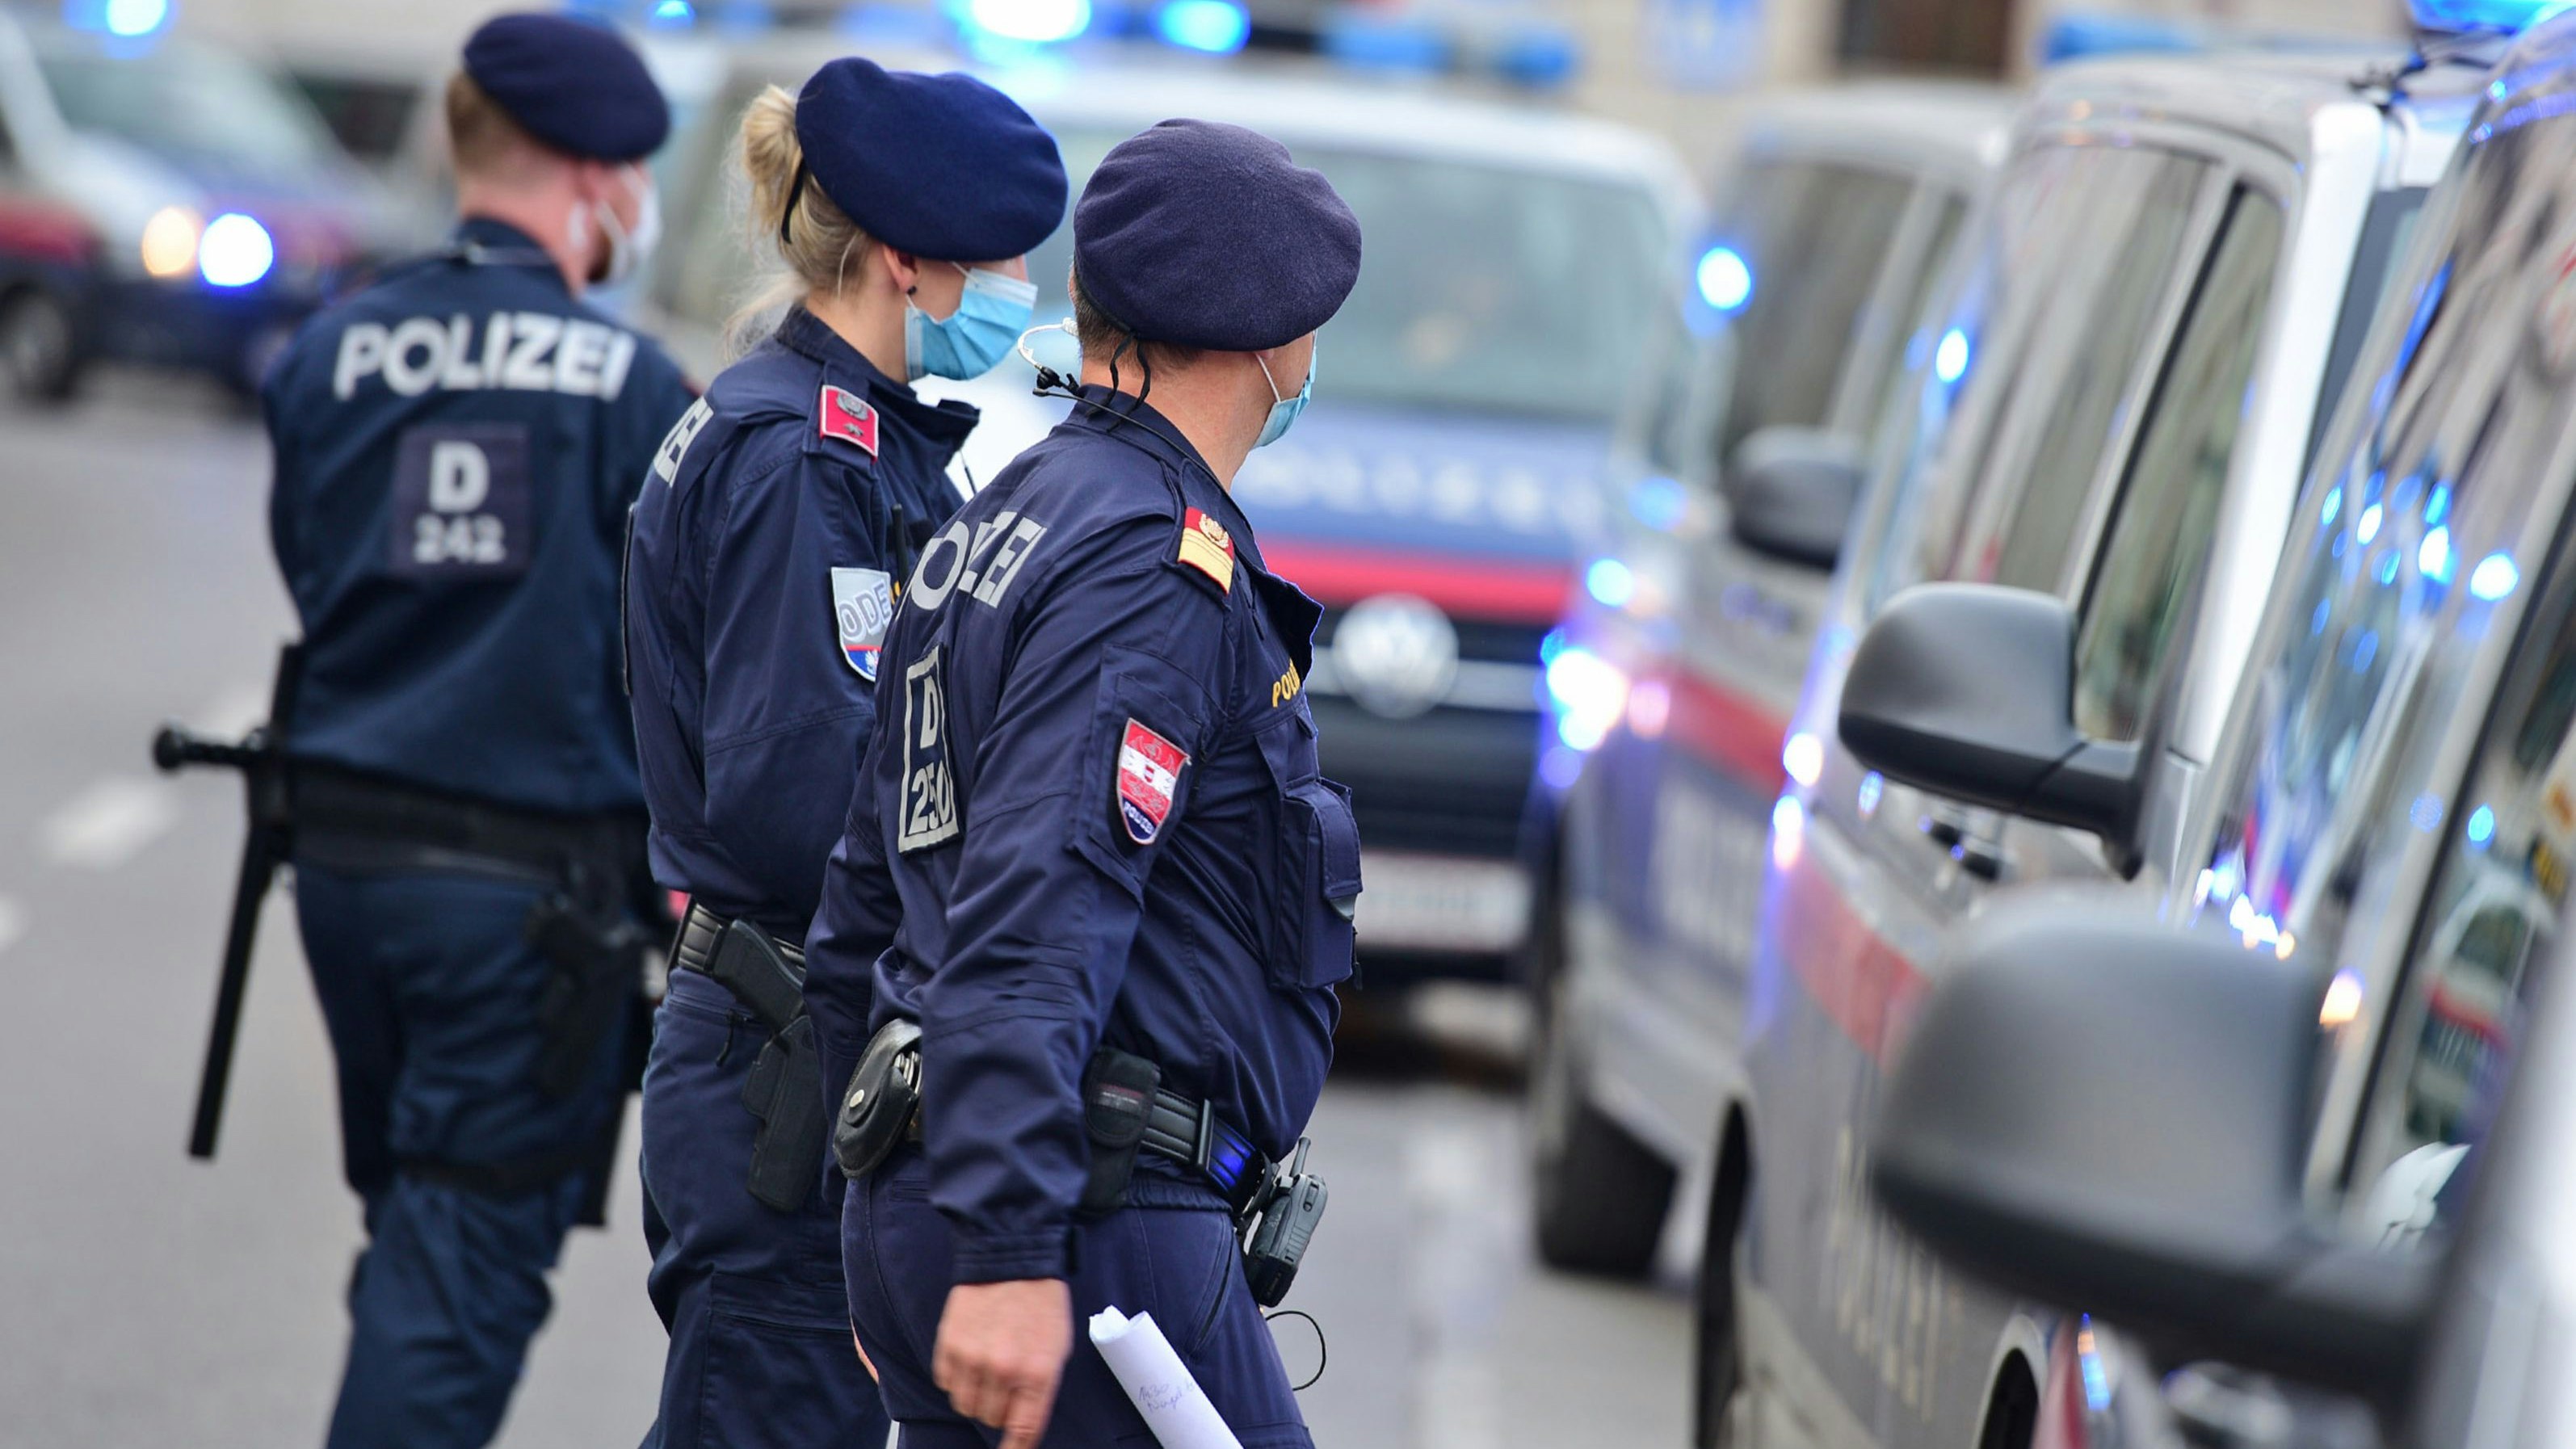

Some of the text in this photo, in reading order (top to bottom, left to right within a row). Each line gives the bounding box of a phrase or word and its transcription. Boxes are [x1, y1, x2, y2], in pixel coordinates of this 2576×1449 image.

[333, 312, 637, 401] POLIZEI
[428, 440, 490, 514] D
[413, 514, 507, 565] 242
[919, 674, 939, 750] D
[908, 759, 952, 835] 250
